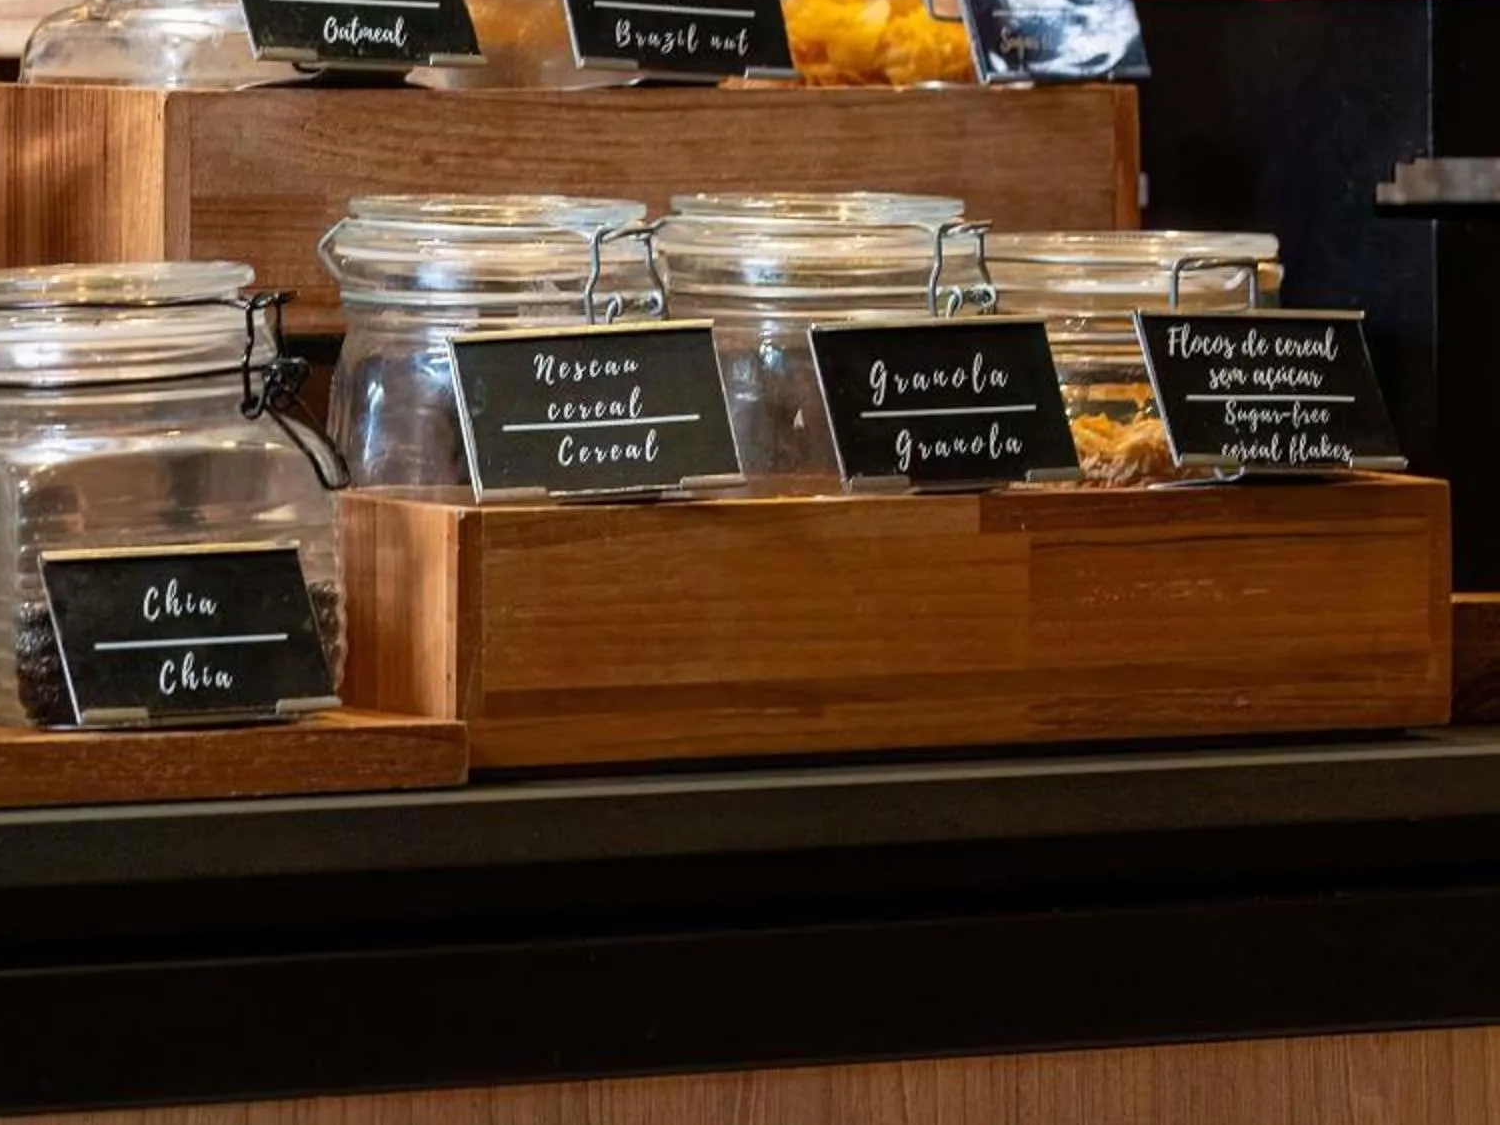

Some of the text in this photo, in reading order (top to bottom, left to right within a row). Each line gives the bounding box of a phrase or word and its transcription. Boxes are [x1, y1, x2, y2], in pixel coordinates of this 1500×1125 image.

[323, 15, 407, 48] Oatmeal
[615, 18, 750, 57] Brazil nut
[1167, 322, 1339, 362] Flocos de cereal
[533, 352, 640, 386] Nescau
[869, 351, 1009, 406] Granola
[1209, 366, 1248, 389] sem
[547, 385, 643, 421] cereal
[557, 428, 660, 466] Cereal
[895, 421, 1023, 472] Granola
[1220, 431, 1283, 462] cereal
[142, 577, 217, 622] Chia
[159, 651, 234, 696] Chia
